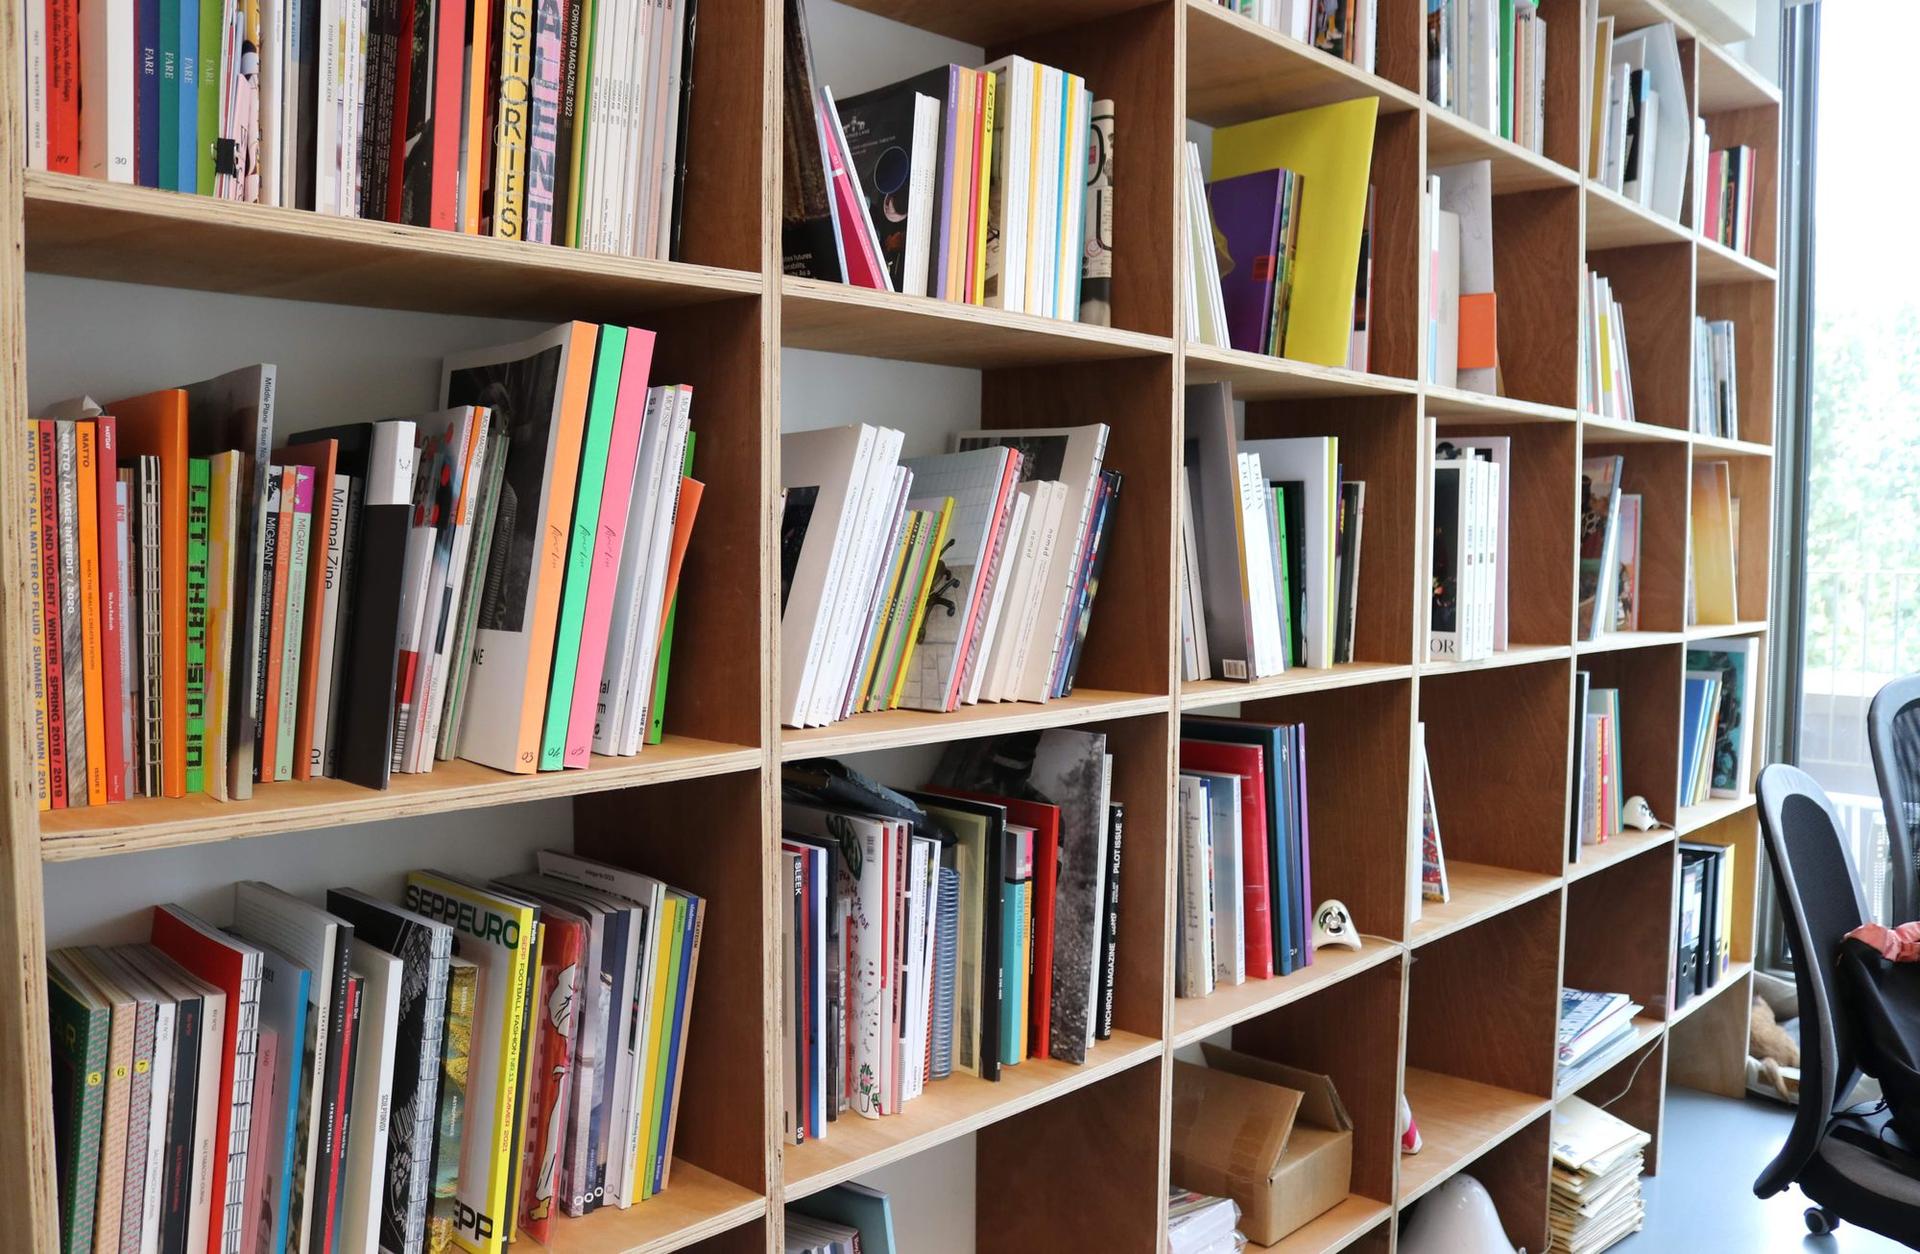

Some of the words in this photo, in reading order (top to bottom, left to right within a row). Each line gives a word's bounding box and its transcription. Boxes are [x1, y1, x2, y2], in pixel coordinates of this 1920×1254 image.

[568, 4, 580, 48] FORWARD
[144, 48, 154, 76] FARE
[164, 52, 174, 80] FARE
[184, 56, 193, 84] FARE
[204, 58, 216, 86] FARE
[566, 50, 576, 96] MAGAZINE
[500, 0, 528, 238] STORIES
[565, 96, 574, 118] 2022
[114, 156, 128, 166] 30
[262, 403, 270, 424] Plane
[480, 416, 489, 434] MOLD
[660, 394, 674, 430] MOUSSE
[678, 394, 690, 432] MOUSSE
[27, 430, 36, 472] MATTO
[62, 432, 70, 471] MATTO
[82, 432, 90, 468] MATTO
[260, 426, 268, 446] Issue
[474, 434, 486, 468] MAGAZINE
[42, 432, 52, 476] MATTO
[28, 482, 38, 504] IT'S
[44, 487, 53, 520] SEXY
[62, 482, 72, 524] LAVAGE
[466, 497, 475, 518] ISSUE
[30, 508, 38, 528] ALL
[190, 484, 208, 546] LET
[326, 488, 346, 550] Minimal
[44, 524, 54, 550] AND
[64, 526, 74, 576] INTERDIT
[264, 516, 276, 566] MIGRANT
[294, 518, 306, 566] MIGRANT
[1025, 530, 1038, 559] nomad
[1042, 528, 1055, 557] nomad
[30, 530, 40, 580] MATTER
[32, 582, 40, 598] OF
[46, 554, 56, 606] VIOLENT
[324, 556, 338, 590] Zine
[66, 586, 74, 614] 2020
[189, 560, 206, 649] THAT
[32, 601, 41, 635] FLUID
[48, 618, 58, 666] WINTER
[33, 646, 43, 698] SUMMER
[50, 676, 60, 722] SPRING
[640, 706, 648, 726] ISSUE
[36, 710, 46, 759] AUTUMN
[52, 726, 62, 756] 2018
[38, 770, 47, 799] 2019
[53, 767, 62, 798] 2019
[1113, 823, 1122, 848] ISSUE
[1112, 849, 1121, 874] PILOT
[794, 862, 802, 896] SLEEK
[520, 935, 528, 960] SEPP
[1106, 942, 1116, 988] MAGAZINE
[514, 962, 526, 1012] FOOTBALL
[1104, 989, 1114, 1036] SYNCHRON
[510, 1014, 520, 1056] FASHION
[90, 1074, 98, 1084] 5
[117, 1067, 125, 1076] 6
[504, 1086, 514, 1127] SUMMER
[502, 1130, 510, 1152] 2021
